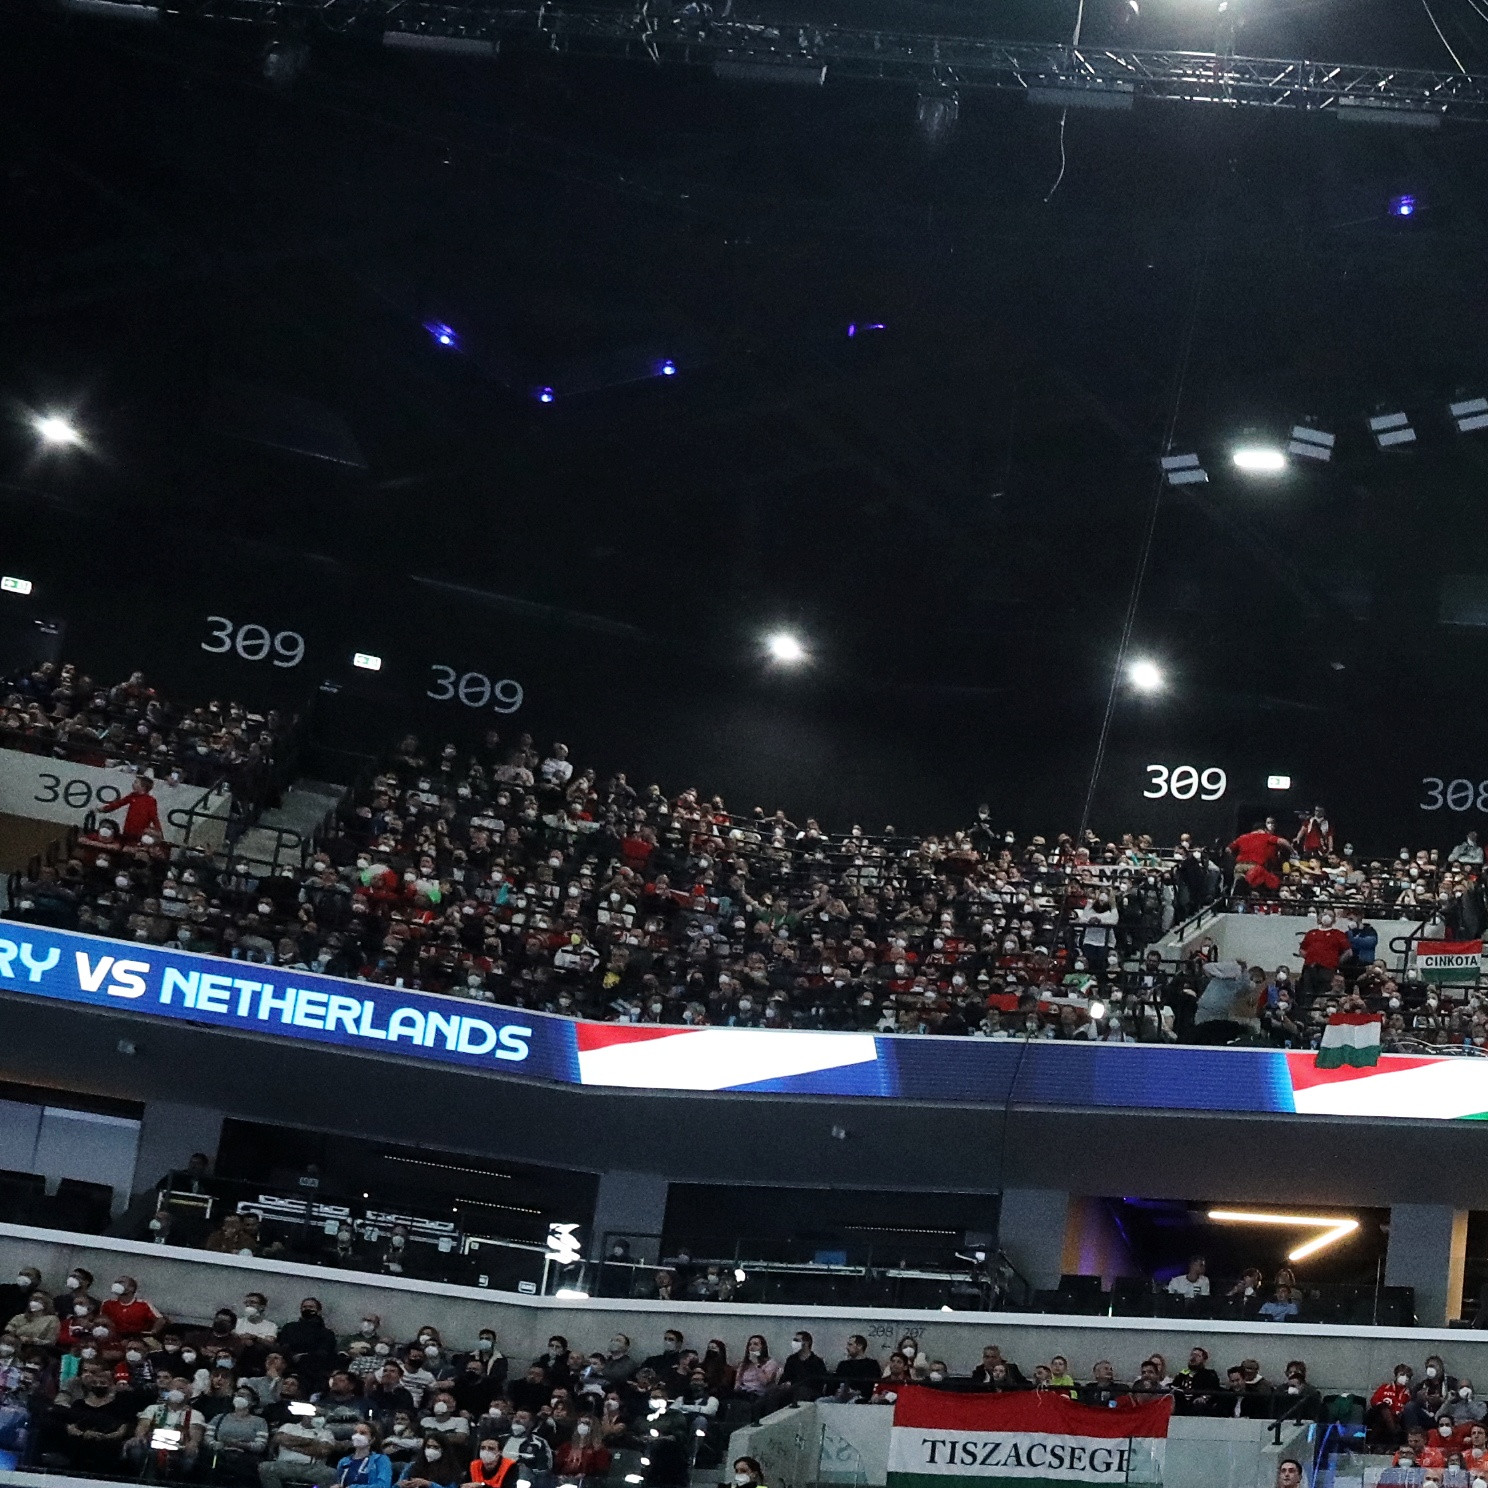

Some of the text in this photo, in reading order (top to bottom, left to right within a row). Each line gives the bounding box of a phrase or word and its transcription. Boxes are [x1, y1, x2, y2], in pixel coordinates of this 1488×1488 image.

[201, 616, 305, 667] 309
[427, 664, 524, 713] 309
[1144, 765, 1227, 801] 309
[1425, 955, 1478, 967] CINKOTA
[74, 952, 150, 998] VS
[160, 967, 532, 1062] NETHERLANDS
[922, 1438, 1137, 1474] TISZACSEGE
